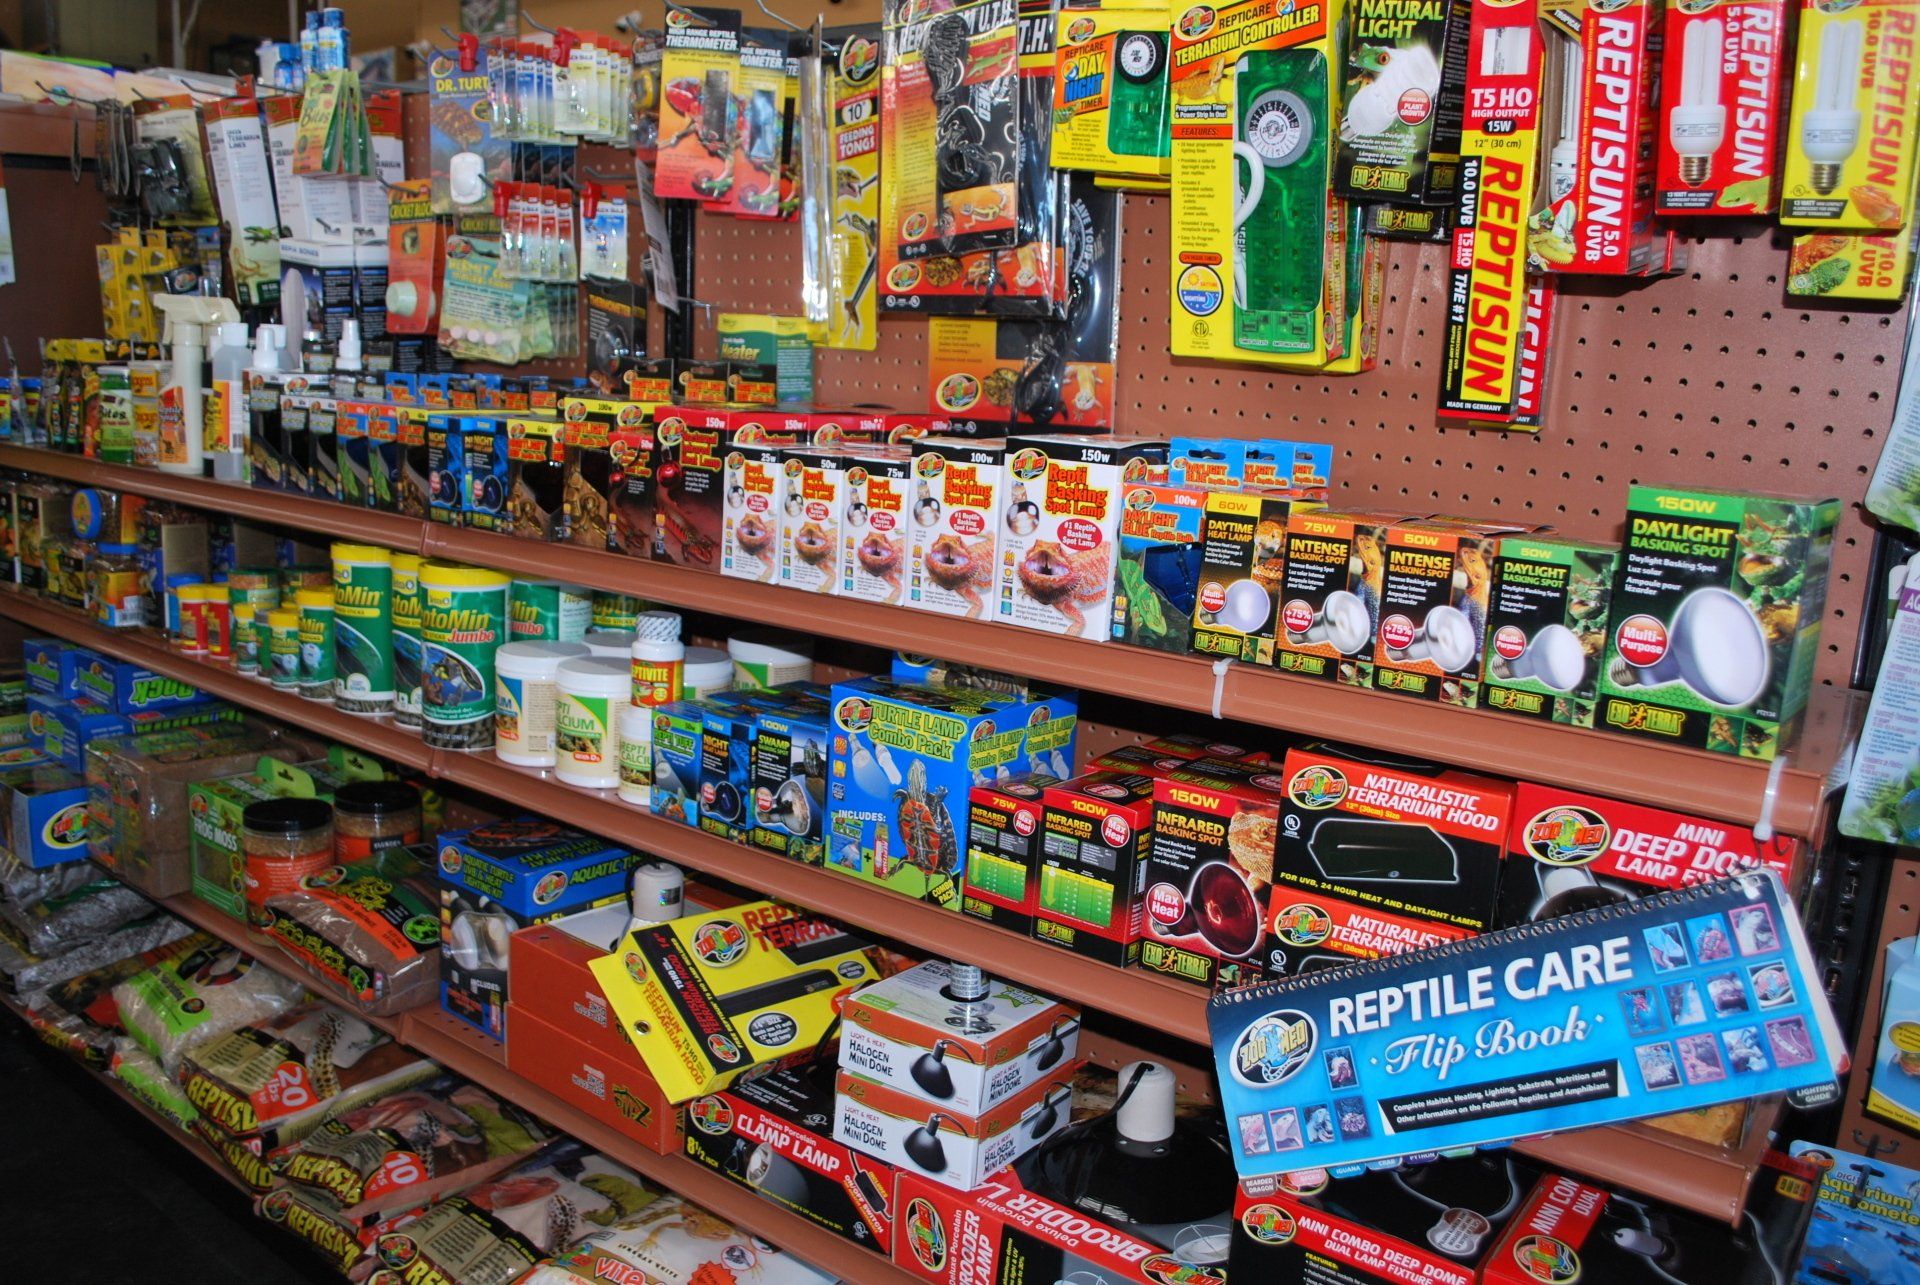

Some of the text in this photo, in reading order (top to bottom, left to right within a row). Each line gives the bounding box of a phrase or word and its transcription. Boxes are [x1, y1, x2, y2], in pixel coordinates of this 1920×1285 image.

[1218, 7, 1271, 30] REPTICARE
[1360, 0, 1444, 20] NATURAL
[1553, 9, 1580, 31] TROPICAL
[709, 30, 736, 39] REPTILE
[1174, 7, 1319, 68] TERRARIUM CONTROLLER
[1358, 19, 1417, 39] LIGHT
[1064, 41, 1105, 60] REPTICARE
[1723, 7, 1739, 75] 5.0 UVB
[1861, 9, 1881, 89] 10.0 UVB
[1077, 53, 1106, 80] DAY
[1063, 72, 1104, 102] NIGHT
[1733, 7, 1774, 178] REPTISUN
[1866, 8, 1916, 187] REPTISUN
[1079, 97, 1104, 110] TIMER
[1471, 88, 1533, 109] T5 HO
[1471, 108, 1530, 118] HIGH OUTPUT
[838, 126, 874, 144] FEEDING
[1486, 120, 1512, 132] 15W
[1585, 16, 1634, 258] REPTISUN 5.0
[839, 138, 875, 158] TONGS
[1490, 139, 1503, 148] (30
[1506, 139, 1522, 148] cm)
[1459, 159, 1477, 226] 10.0 UVB
[1585, 224, 1603, 262] UVB
[1464, 155, 1524, 398] REPTISUN
[1451, 273, 1469, 323] THE #1
[721, 346, 760, 362] Heater
[1446, 401, 1464, 409] MADE
[1472, 402, 1501, 412] GERMANY
[761, 452, 776, 463] 25w
[820, 458, 837, 471] 50w
[970, 452, 994, 464] 100w
[1080, 449, 1110, 463] 150w
[887, 466, 904, 479] 75w
[1047, 463, 1087, 486] Repti
[1047, 480, 1108, 507] Basking
[1174, 494, 1198, 507] 100w
[1655, 495, 1717, 513] 150W
[1046, 498, 1105, 520] Spot Lamp
[1123, 509, 1178, 527] DAYLIGHT
[1122, 521, 1149, 538] BLUE
[1174, 531, 1194, 543] Bulb
[1208, 520, 1253, 533] DAYTIME
[1208, 530, 1252, 543] HEAT LAMP
[1632, 518, 1733, 546] DAYLIGHT
[1290, 539, 1348, 557] INTENSE
[1290, 552, 1346, 565] BASKING SPOT
[1630, 536, 1729, 559] BASKING SPOT
[1629, 554, 1717, 574] Daylight Basking Spot
[448, 628, 495, 643] Jumbo
[1623, 627, 1663, 643] Multi-
[1620, 638, 1664, 657] Purpose
[872, 700, 964, 738] TURTLE LAMP
[702, 734, 729, 749] NIGHT
[758, 734, 790, 749] SWAMP
[869, 725, 952, 760] Combo Pack
[1170, 789, 1220, 810] 150W
[1364, 773, 1480, 811] NATURALISTIC
[838, 809, 886, 822] INCLUDES:
[1071, 799, 1109, 816] 100W
[1348, 786, 1499, 831] TERRARIUM HOOD
[1046, 812, 1092, 832] INFRARED
[1157, 811, 1225, 836] INFRARED
[213, 826, 238, 851] MOSS
[1156, 824, 1223, 846] BASKING SPOT
[1610, 827, 1689, 862] DEEP
[1674, 822, 1726, 847] MINI
[1614, 854, 1677, 880] LAMP
[1153, 889, 1179, 906] Max
[1280, 872, 1482, 928] FOR UVB, 24 HOUR HEAT AND DAYLIGHT LAMPS
[1151, 901, 1179, 919] Heat
[1145, 943, 1206, 979] EXO TERRA
[1329, 940, 1632, 1038] REPTILE CARE
[647, 981, 683, 1033] REPTISUN
[642, 987, 704, 1085] TERRARIUM HOOD
[1384, 1005, 1592, 1080] Flip Book
[850, 1039, 889, 1063] HALOGEN
[849, 1053, 893, 1077] MINI DOME
[277, 1066, 308, 1107] 20
[1393, 1100, 1425, 1112] Complete
[1556, 1073, 1590, 1085] Nutrition
[1591, 1069, 1606, 1078] and
[1796, 1084, 1835, 1100] LIGHTING
[1805, 1092, 1830, 1103] GUIDE
[1397, 1082, 1610, 1124] Other Information on the Following Reptiles and Amphibians
[759, 1114, 816, 1146] Deluxe Porcelain
[737, 1114, 840, 1173] CLAMP LAMP
[385, 1153, 419, 1185] 10
[1336, 1165, 1360, 1175] IGUANA
[1246, 1177, 1273, 1187] BEARDED
[1248, 1184, 1274, 1193] DRAGON
[863, 1199, 884, 1233] SWITCH
[977, 1197, 1080, 1247] Deluxe Porcelain
[1006, 1193, 1151, 1262] BROODER
[1298, 1216, 1468, 1285] MINI COMBO DEEP DOME
[1324, 1240, 1434, 1285] DUAL LAMP FIXTURE
